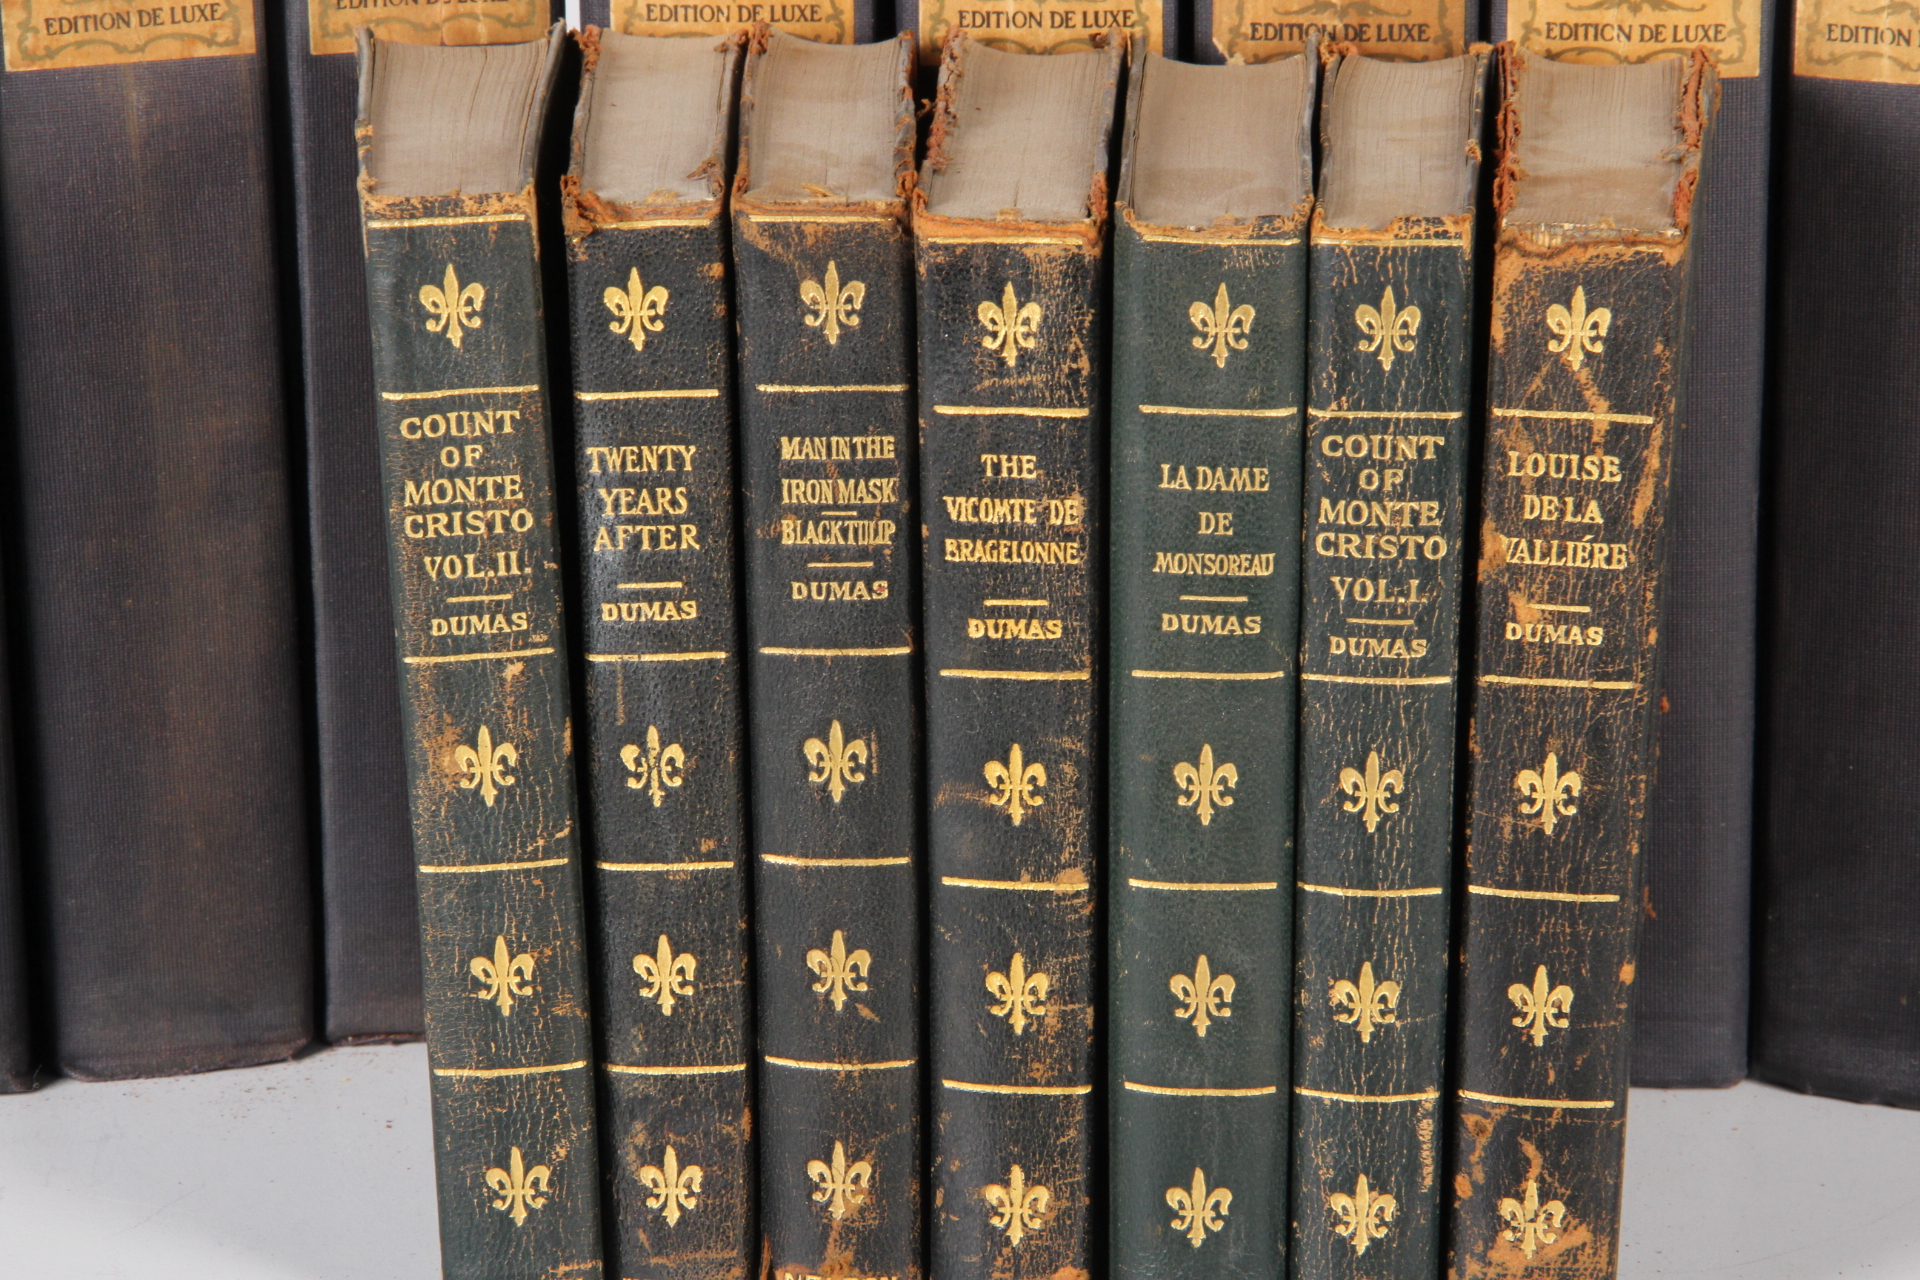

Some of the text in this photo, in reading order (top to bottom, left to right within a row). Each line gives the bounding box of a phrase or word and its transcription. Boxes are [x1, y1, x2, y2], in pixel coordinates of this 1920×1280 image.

[44, 3, 222, 36] EDITION DE LUXE
[645, 4, 822, 23] EDITION DE LUXE
[958, 10, 1135, 29] EDITION DE LUXE
[1250, 22, 1430, 42] EDITION DE LUXE
[1545, 22, 1726, 43] EDITION DE LUXE
[1826, 23, 1912, 47] EDITION
[400, 410, 521, 439] COUNT
[440, 444, 483, 468] OF
[586, 445, 697, 473] TWENTY
[781, 436, 896, 460] MAN IN THE
[1321, 434, 1445, 461] COUNT
[981, 454, 1037, 479] THE
[1158, 463, 1270, 492] LA DAME
[1508, 450, 1623, 482] LOUISE
[404, 474, 524, 507] MONTE
[781, 477, 898, 505] IRON MASK
[1359, 468, 1404, 491] OF
[598, 487, 688, 516] YEARS
[943, 496, 1079, 525] VICOMTE DE
[1318, 497, 1440, 527] MONTE
[1523, 494, 1604, 524] DE LA
[404, 508, 534, 538] CRISTO
[781, 520, 896, 545] BLACK TULIP
[1198, 511, 1233, 535] DE
[593, 524, 700, 552] AFTER
[1315, 532, 1447, 560] CRISTO
[945, 538, 1081, 564] BRAGELONNE
[1152, 552, 1276, 576] MONSOREAU
[791, 580, 889, 601] DUMAS
[601, 600, 698, 621] DUMAS
[431, 612, 528, 636] DUMAS
[967, 618, 1063, 639] DUMAS
[1161, 613, 1261, 635] DUMAS
[1505, 622, 1604, 646] DUMAS
[1329, 635, 1428, 658] DUMAS
